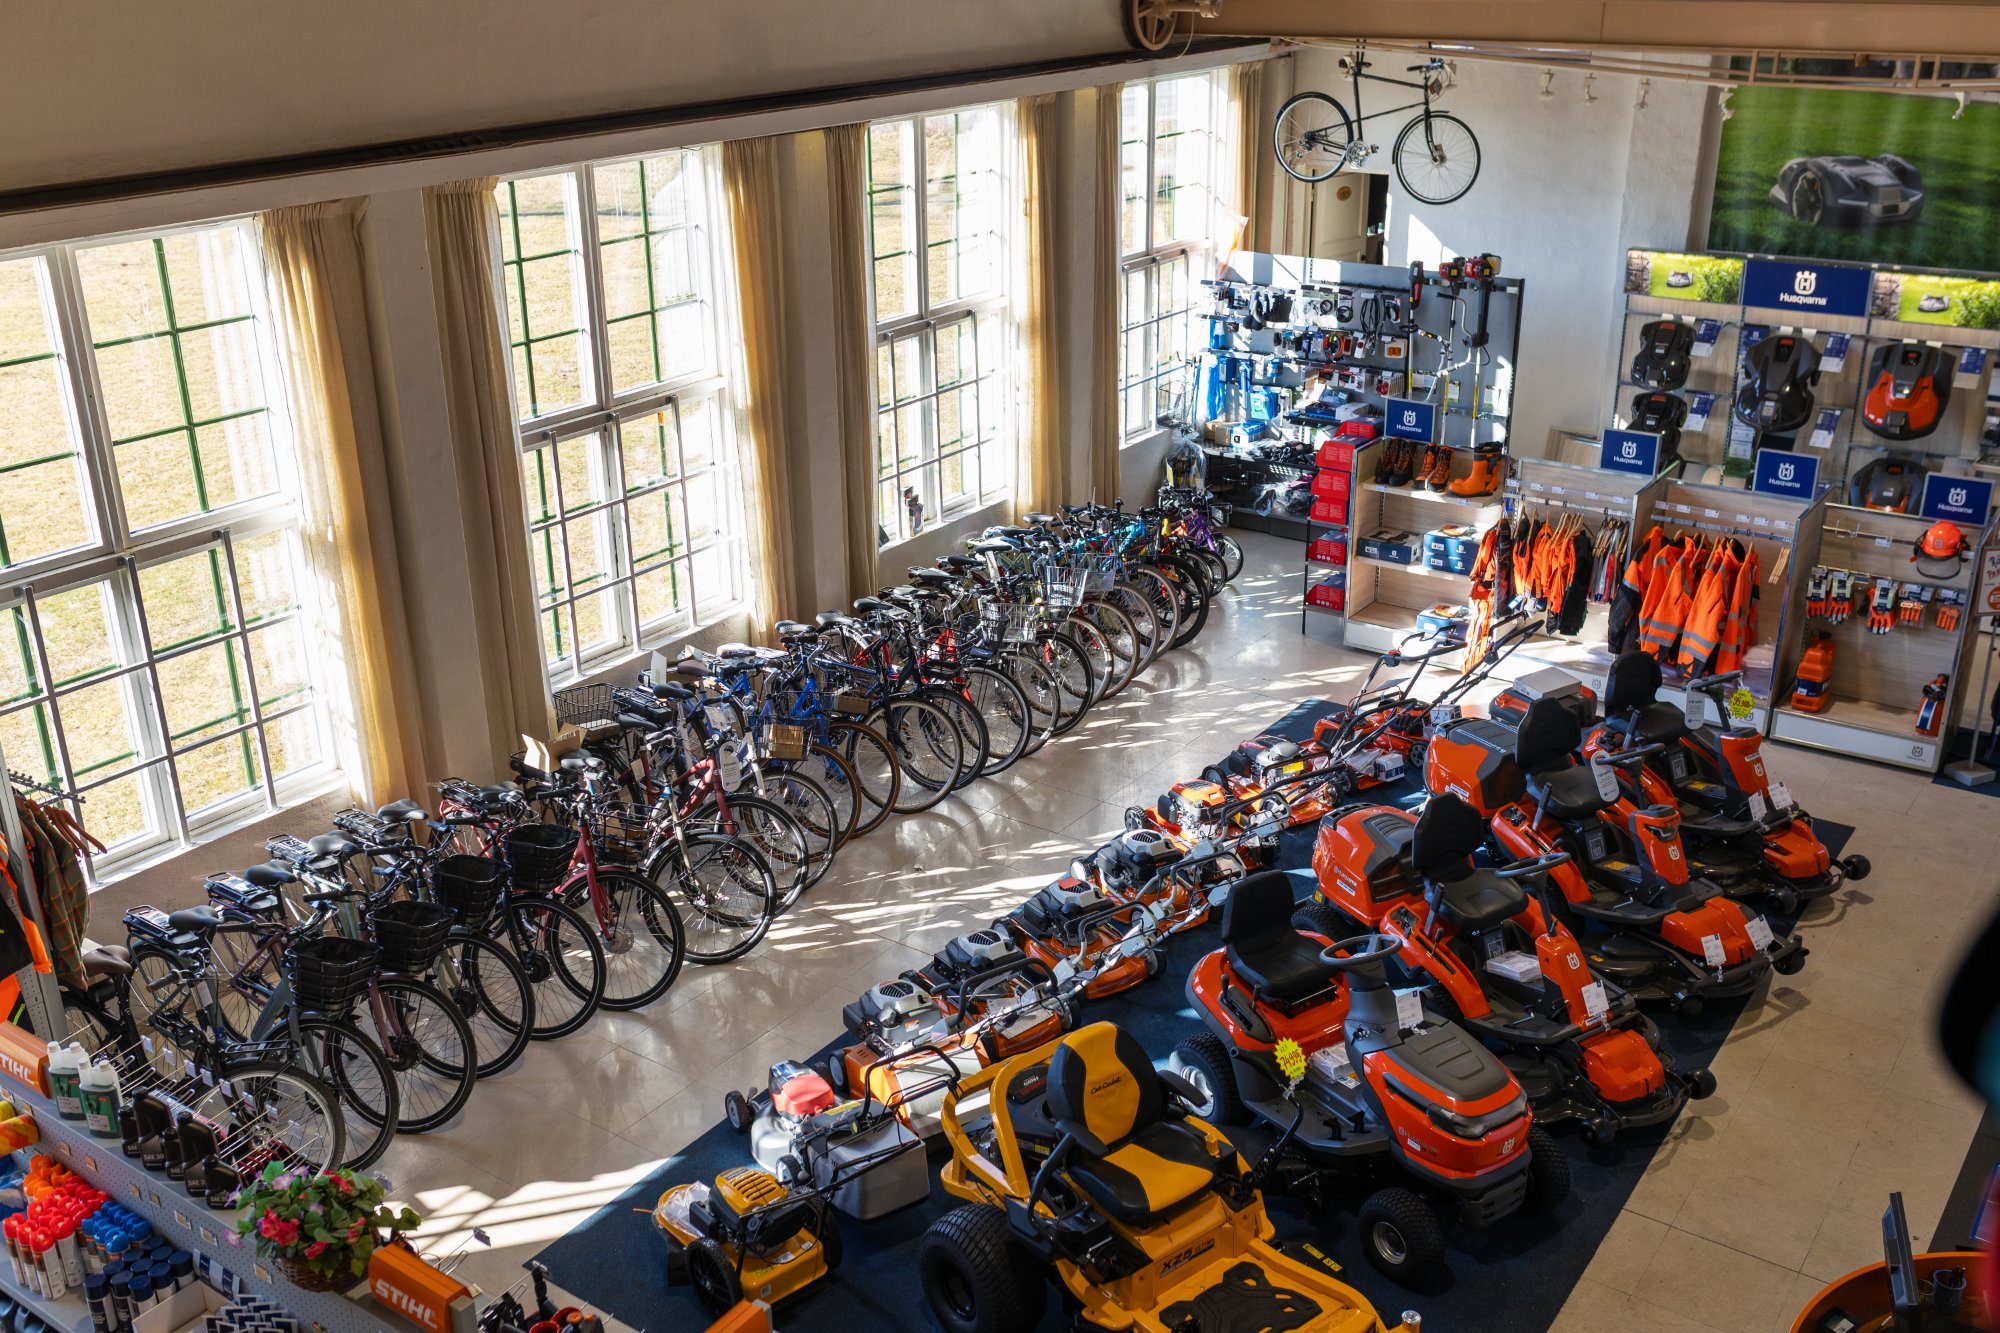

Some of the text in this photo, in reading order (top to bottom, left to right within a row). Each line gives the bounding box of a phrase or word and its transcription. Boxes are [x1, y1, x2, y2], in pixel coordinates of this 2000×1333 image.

[1780, 292, 1828, 305] Husqvarna
[1396, 424, 1422, 433] Husqvarna
[1613, 456, 1643, 466] Husqvarna
[1768, 477, 1801, 489] Husqvarna
[1937, 503, 1973, 514] Husqvarna
[0, 1052, 35, 1086] TIHL
[375, 1278, 438, 1330] STIHL
